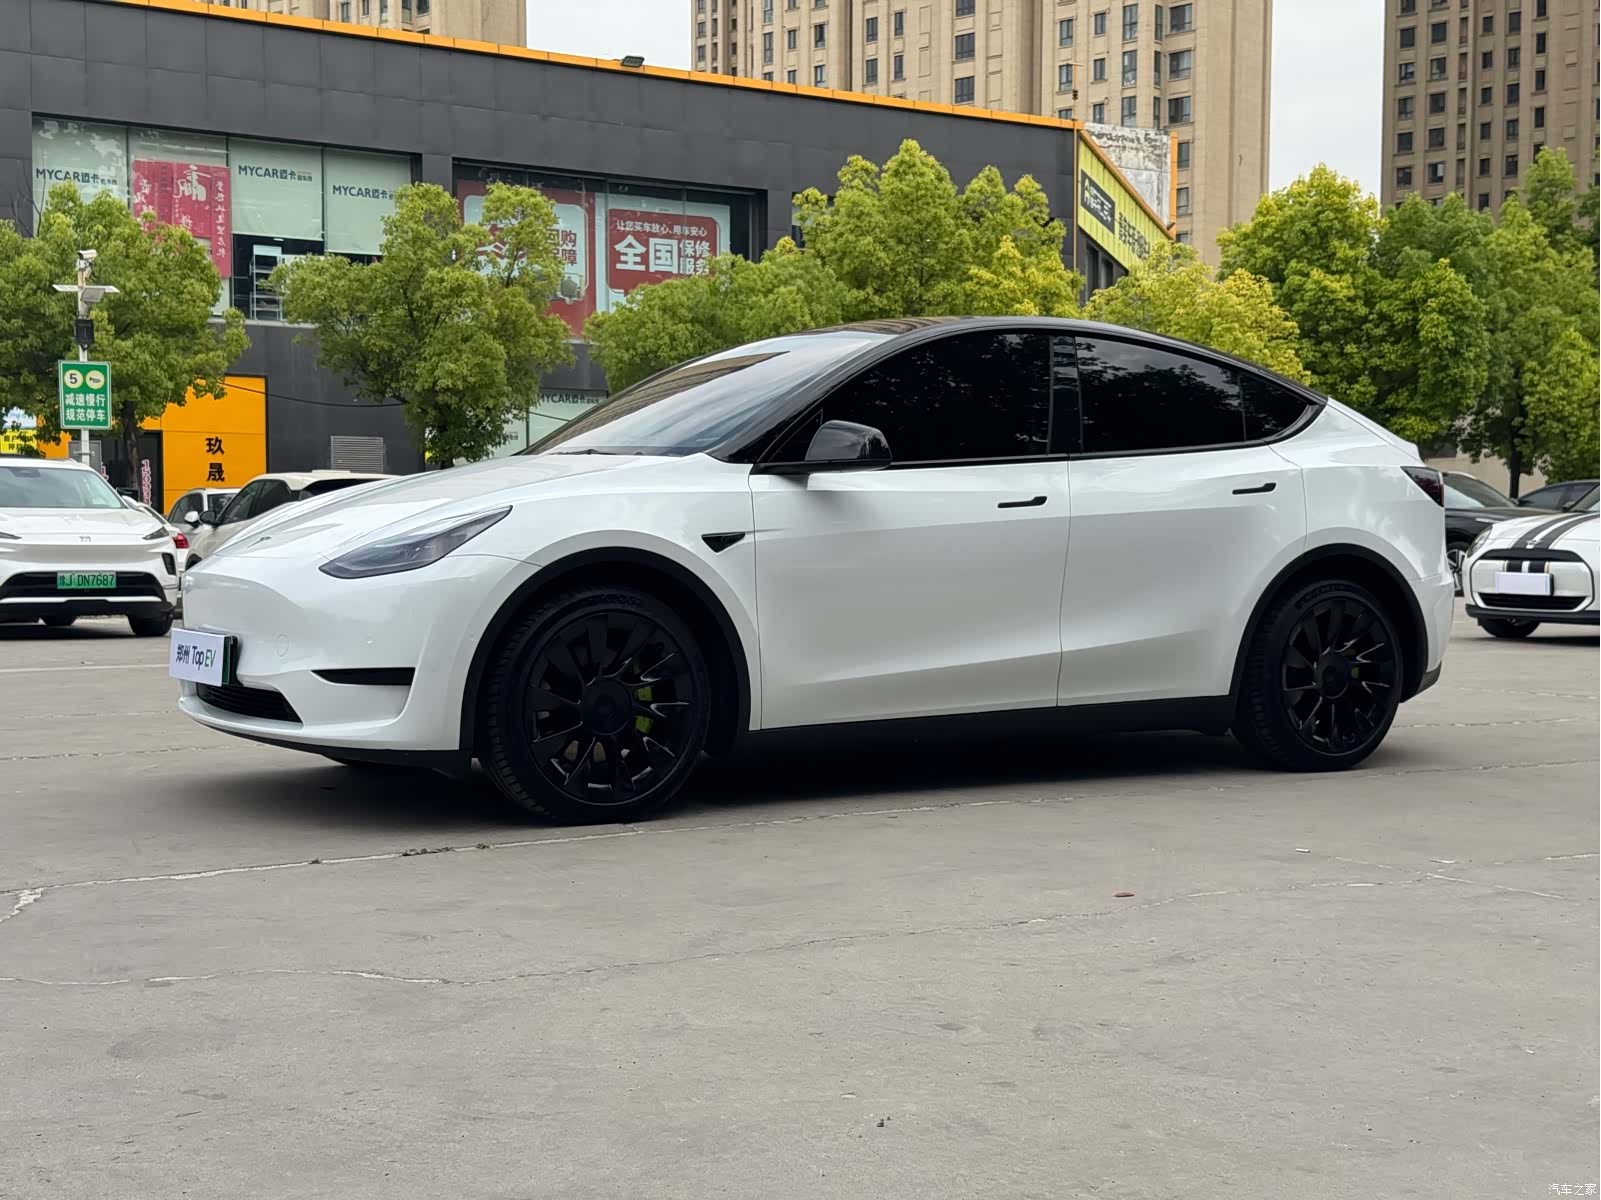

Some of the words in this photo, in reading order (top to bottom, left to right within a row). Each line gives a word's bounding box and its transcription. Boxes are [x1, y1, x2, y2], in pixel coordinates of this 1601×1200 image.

[69, 373, 78, 385] 5
[65, 393, 105, 407] 减速慢行
[65, 408, 105, 421] 规范停车
